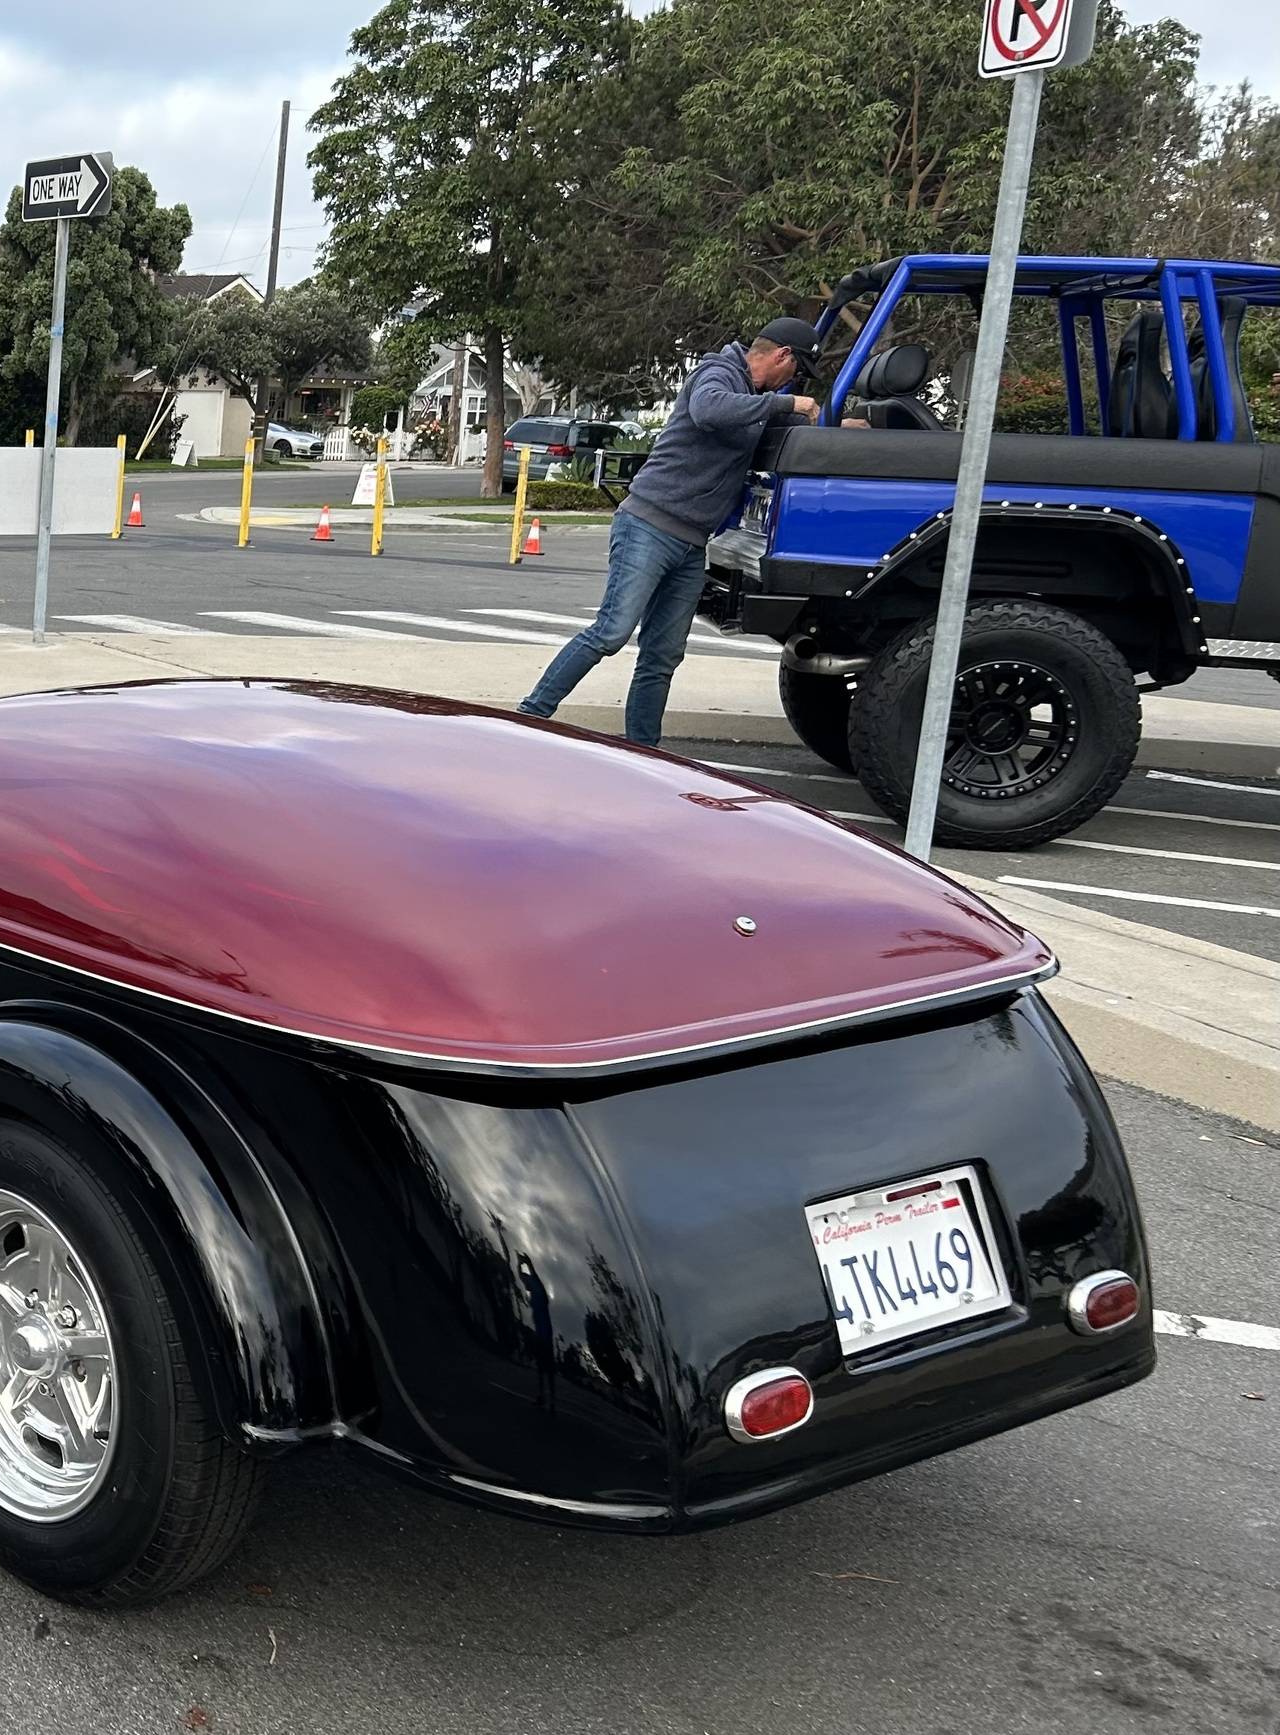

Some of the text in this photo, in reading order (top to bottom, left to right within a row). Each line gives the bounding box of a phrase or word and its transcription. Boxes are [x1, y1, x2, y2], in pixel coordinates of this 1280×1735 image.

[32, 174, 82, 202] ONE WAY
[823, 1220, 872, 1245] California
[874, 1211, 902, 1228] Perm
[904, 1201, 939, 1219] Trailer
[823, 1227, 973, 1325] 4TK4469
